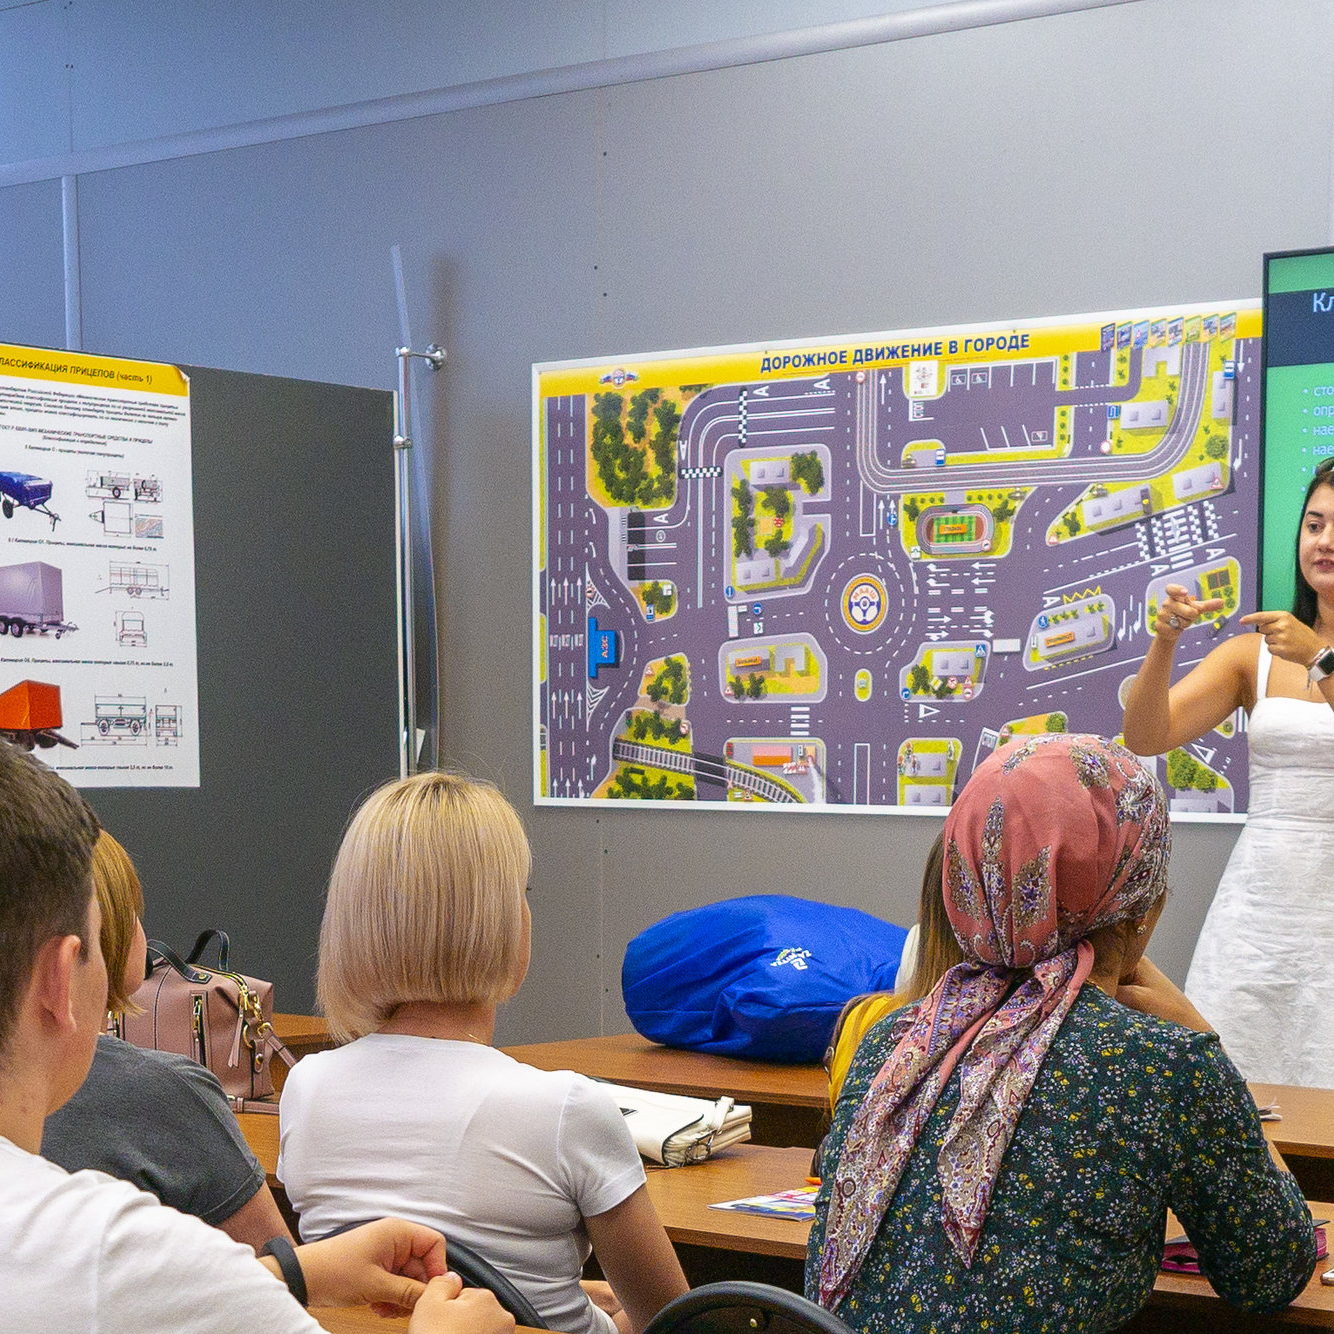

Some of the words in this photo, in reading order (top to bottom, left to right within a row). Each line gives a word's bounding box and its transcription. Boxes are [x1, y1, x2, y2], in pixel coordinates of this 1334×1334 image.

[760, 350, 848, 373] ДОРОЖНОЕ
[852, 341, 943, 365] ДВИЖЕНИЕ
[948, 339, 958, 354] В
[963, 333, 1030, 354] ГОРОДЕ
[116, 371, 144, 382] (часть
[146, 374, 153, 385] 1)
